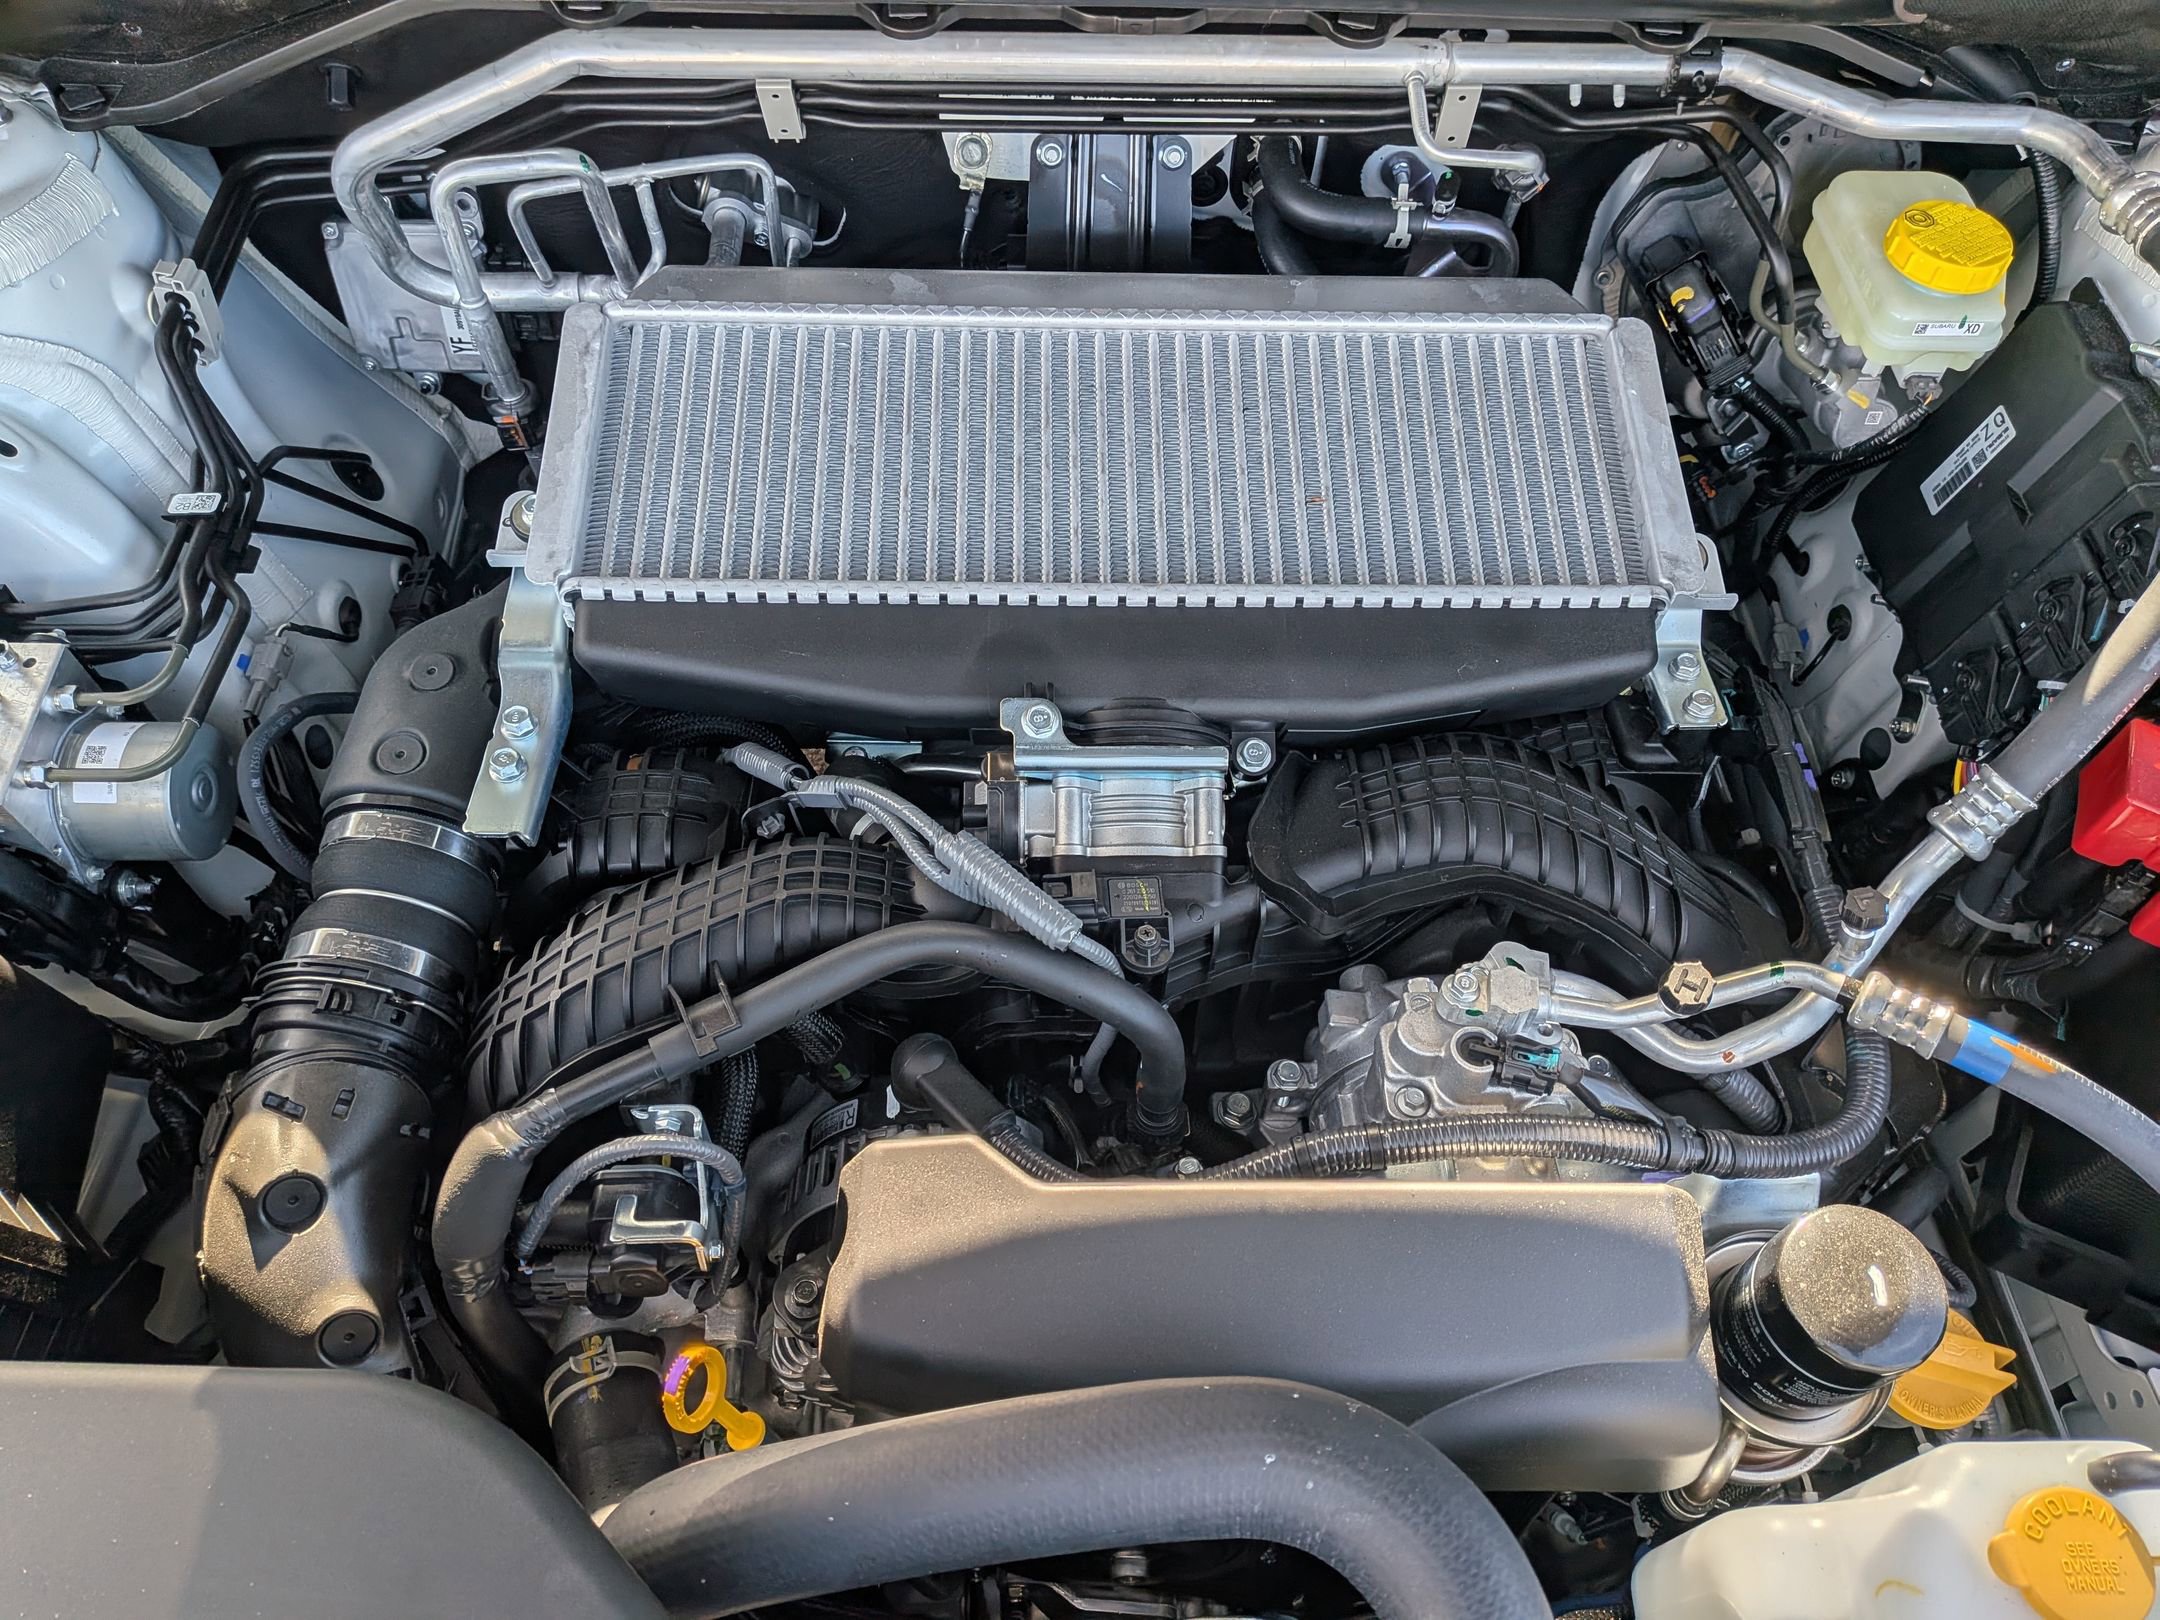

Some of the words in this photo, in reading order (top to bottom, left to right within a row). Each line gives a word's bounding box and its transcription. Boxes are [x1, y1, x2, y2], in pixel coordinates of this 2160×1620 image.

[1963, 323, 1981, 334] XD
[450, 337, 474, 354] YF
[2024, 1494, 2133, 1541] COOLANT
[2065, 1541, 2095, 1557] SEE
[2066, 1576, 2125, 1594] MANUAL
